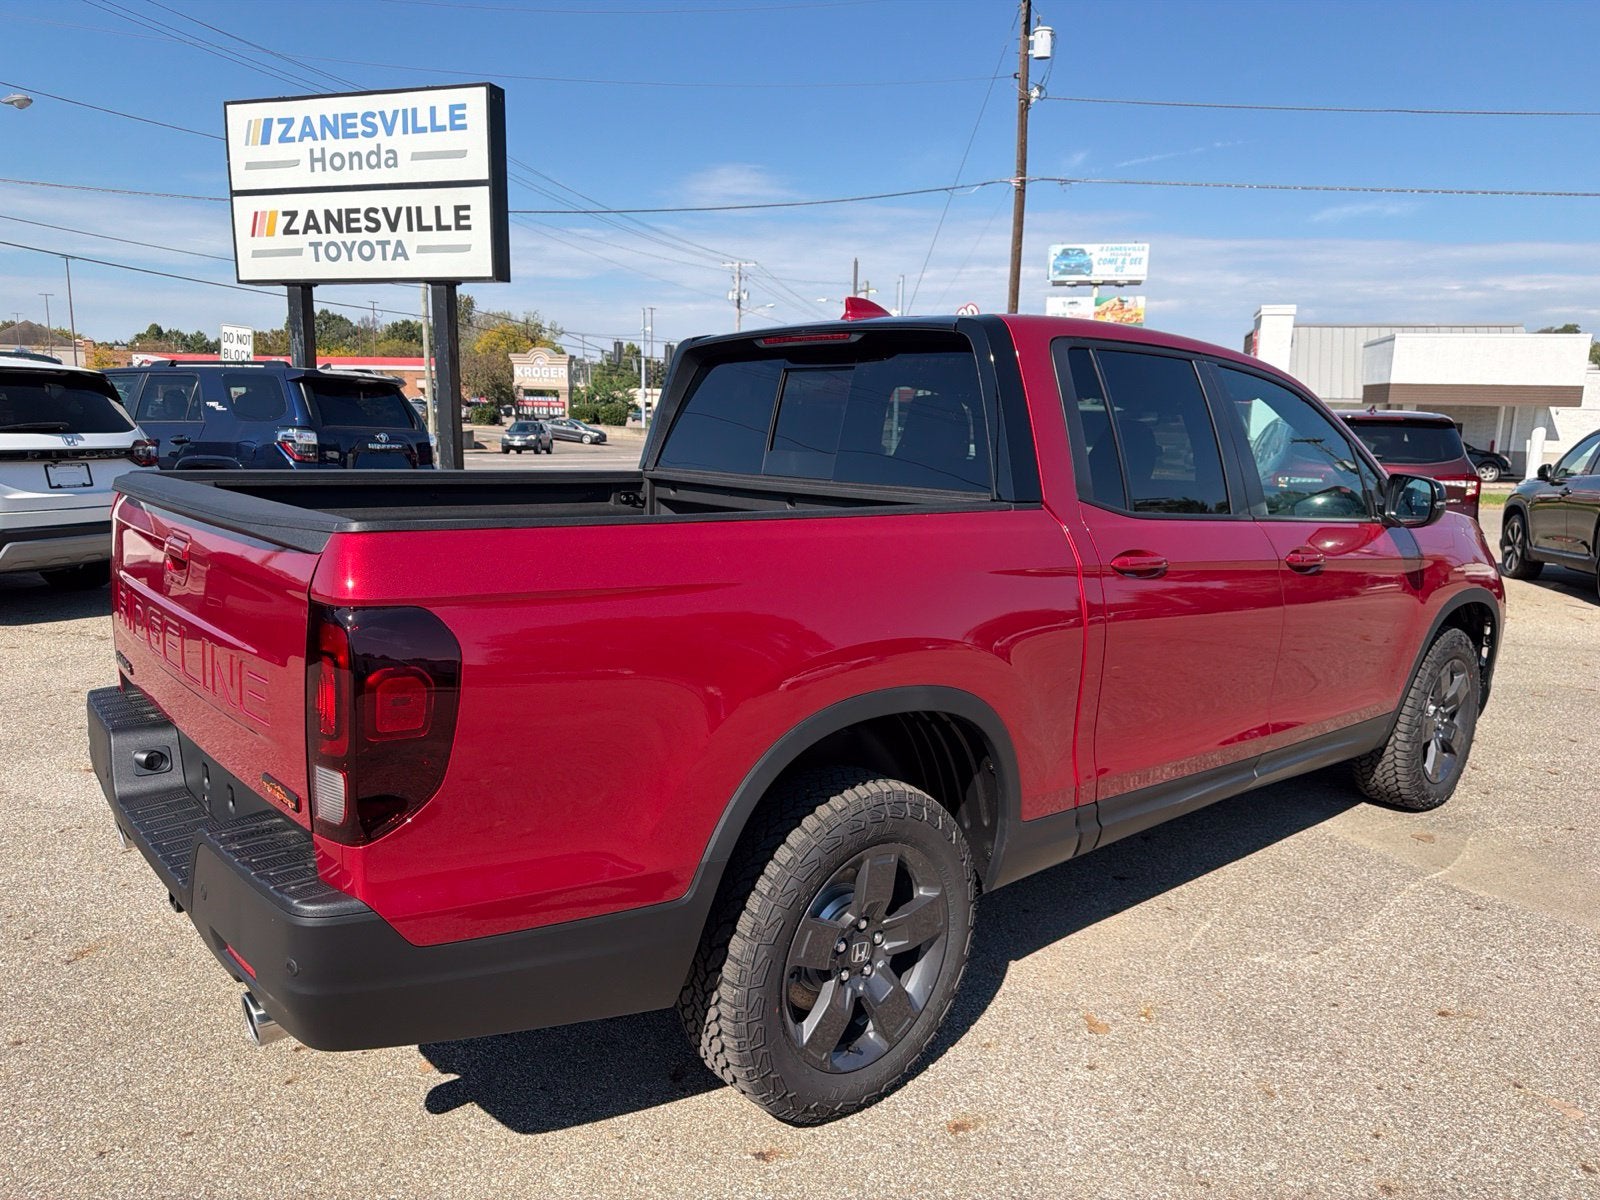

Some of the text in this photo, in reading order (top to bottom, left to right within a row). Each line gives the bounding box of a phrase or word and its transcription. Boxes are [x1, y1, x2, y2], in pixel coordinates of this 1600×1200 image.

[277, 103, 468, 143] ZANESVILLE
[309, 143, 399, 173] Honda
[281, 204, 472, 236] ZANESVILLE
[308, 239, 410, 263] TOYOTA
[1097, 257, 1118, 266] COME
[223, 331, 251, 346] DO NOT
[223, 348, 251, 361] BLOCK
[515, 366, 567, 378] KROGER
[117, 580, 270, 727] RIDGELINE
